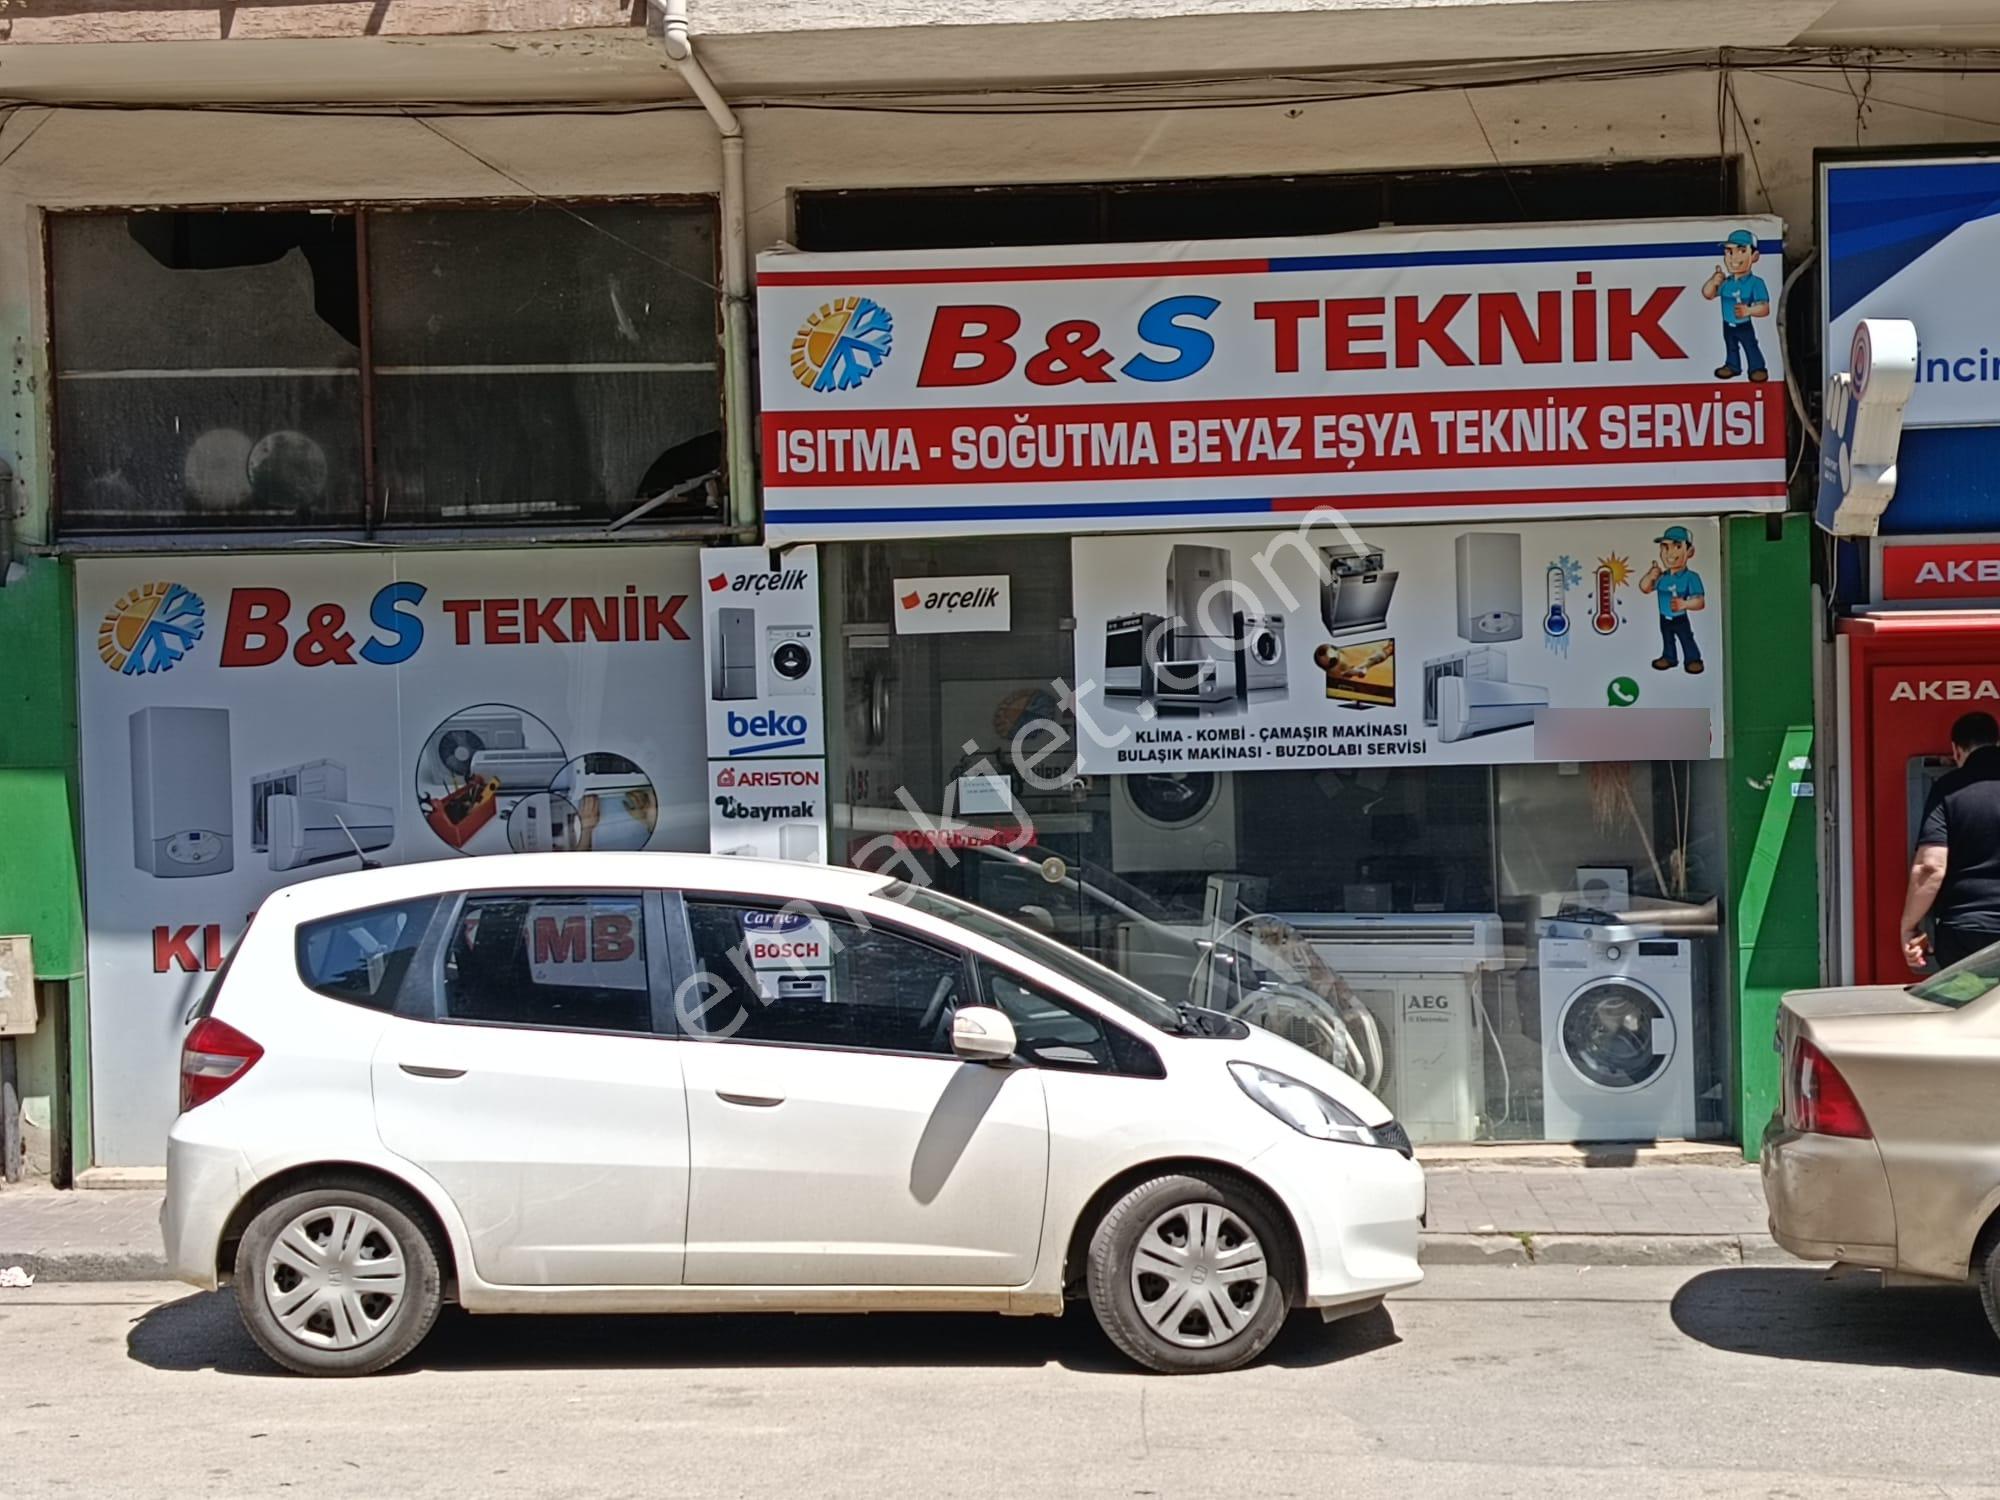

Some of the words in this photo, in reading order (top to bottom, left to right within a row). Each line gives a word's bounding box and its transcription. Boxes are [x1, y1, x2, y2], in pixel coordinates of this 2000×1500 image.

[917, 295, 1221, 388] B&S
[1254, 271, 1688, 373] TEKNİK
[777, 428, 920, 473] ISITMA
[951, 413, 1156, 470] SOĞUTMA
[1170, 416, 1302, 464] BEYAZ
[1314, 412, 1421, 470] EŞYA
[1431, 396, 1588, 455] TEKNİK
[1600, 390, 1764, 450] SERVİSİ
[731, 569, 808, 596] arçelik
[924, 587, 1000, 613] arçelik
[219, 581, 428, 668] B&S
[443, 585, 691, 645] TEKNİK
[1889, 679, 2000, 701] AKBA
[728, 711, 807, 737] beko
[1136, 728, 1183, 743] KLİMA
[1196, 725, 1245, 741] KOMBİ
[1259, 725, 1330, 742] ÇAMAŞIR
[1332, 722, 1407, 739] MAKİNASI
[1117, 748, 1183, 764] BULAŞIK
[1187, 744, 1262, 760] MAKİNASI
[1276, 742, 1363, 758] BUZDOLABI
[1367, 739, 1427, 755] SERVİSİ
[737, 770, 819, 787] ARISTON
[737, 800, 814, 822] baymak
[754, 942, 820, 959] BOSCH
[1408, 995, 1449, 1009] AEG
